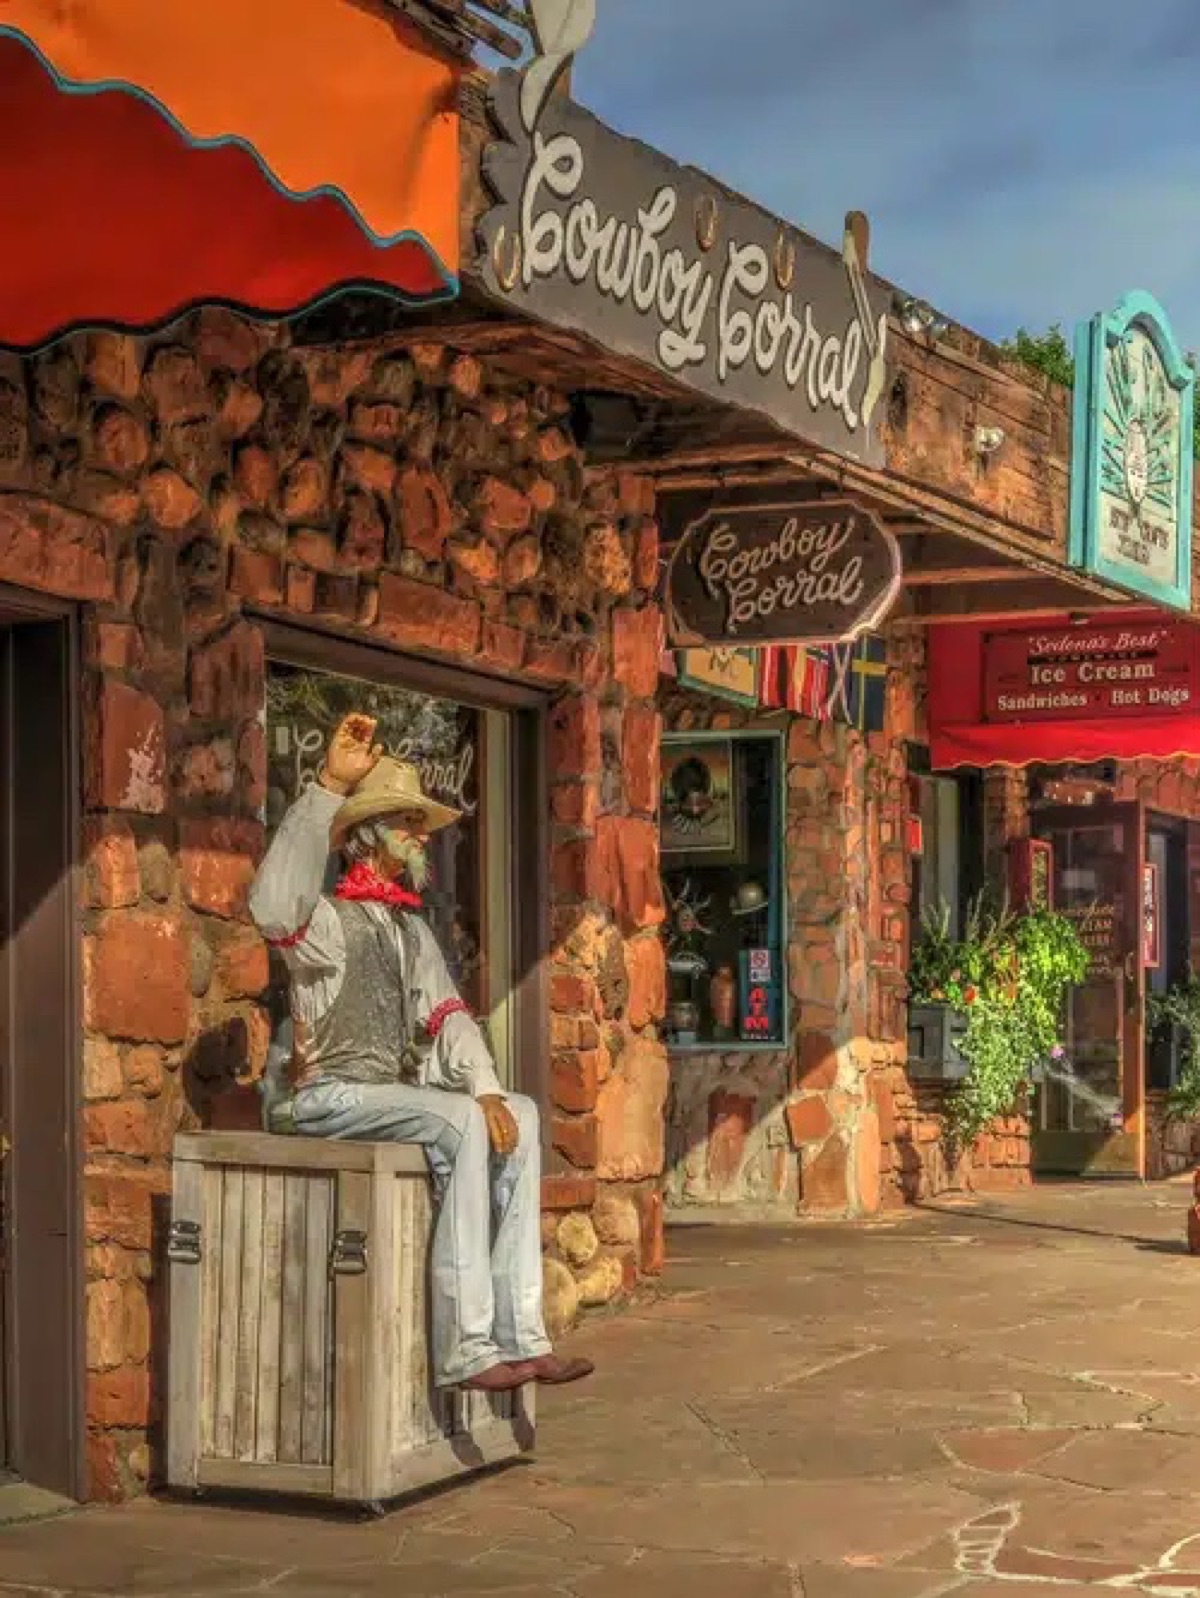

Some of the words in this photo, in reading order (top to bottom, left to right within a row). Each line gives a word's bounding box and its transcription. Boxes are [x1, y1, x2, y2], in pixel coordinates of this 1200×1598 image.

[521, 132, 713, 369] Cowboy
[719, 240, 867, 429] Corral
[700, 516, 855, 598] Cowboy
[725, 556, 865, 634] Corral
[998, 693, 1088, 711] Sandwiches
[1112, 690, 1141, 705] Hot
[1149, 687, 1191, 707] Dogs
[1031, 666, 1066, 685] Ice
[1078, 662, 1156, 682] Cream
[743, 987, 769, 1031] ATM
